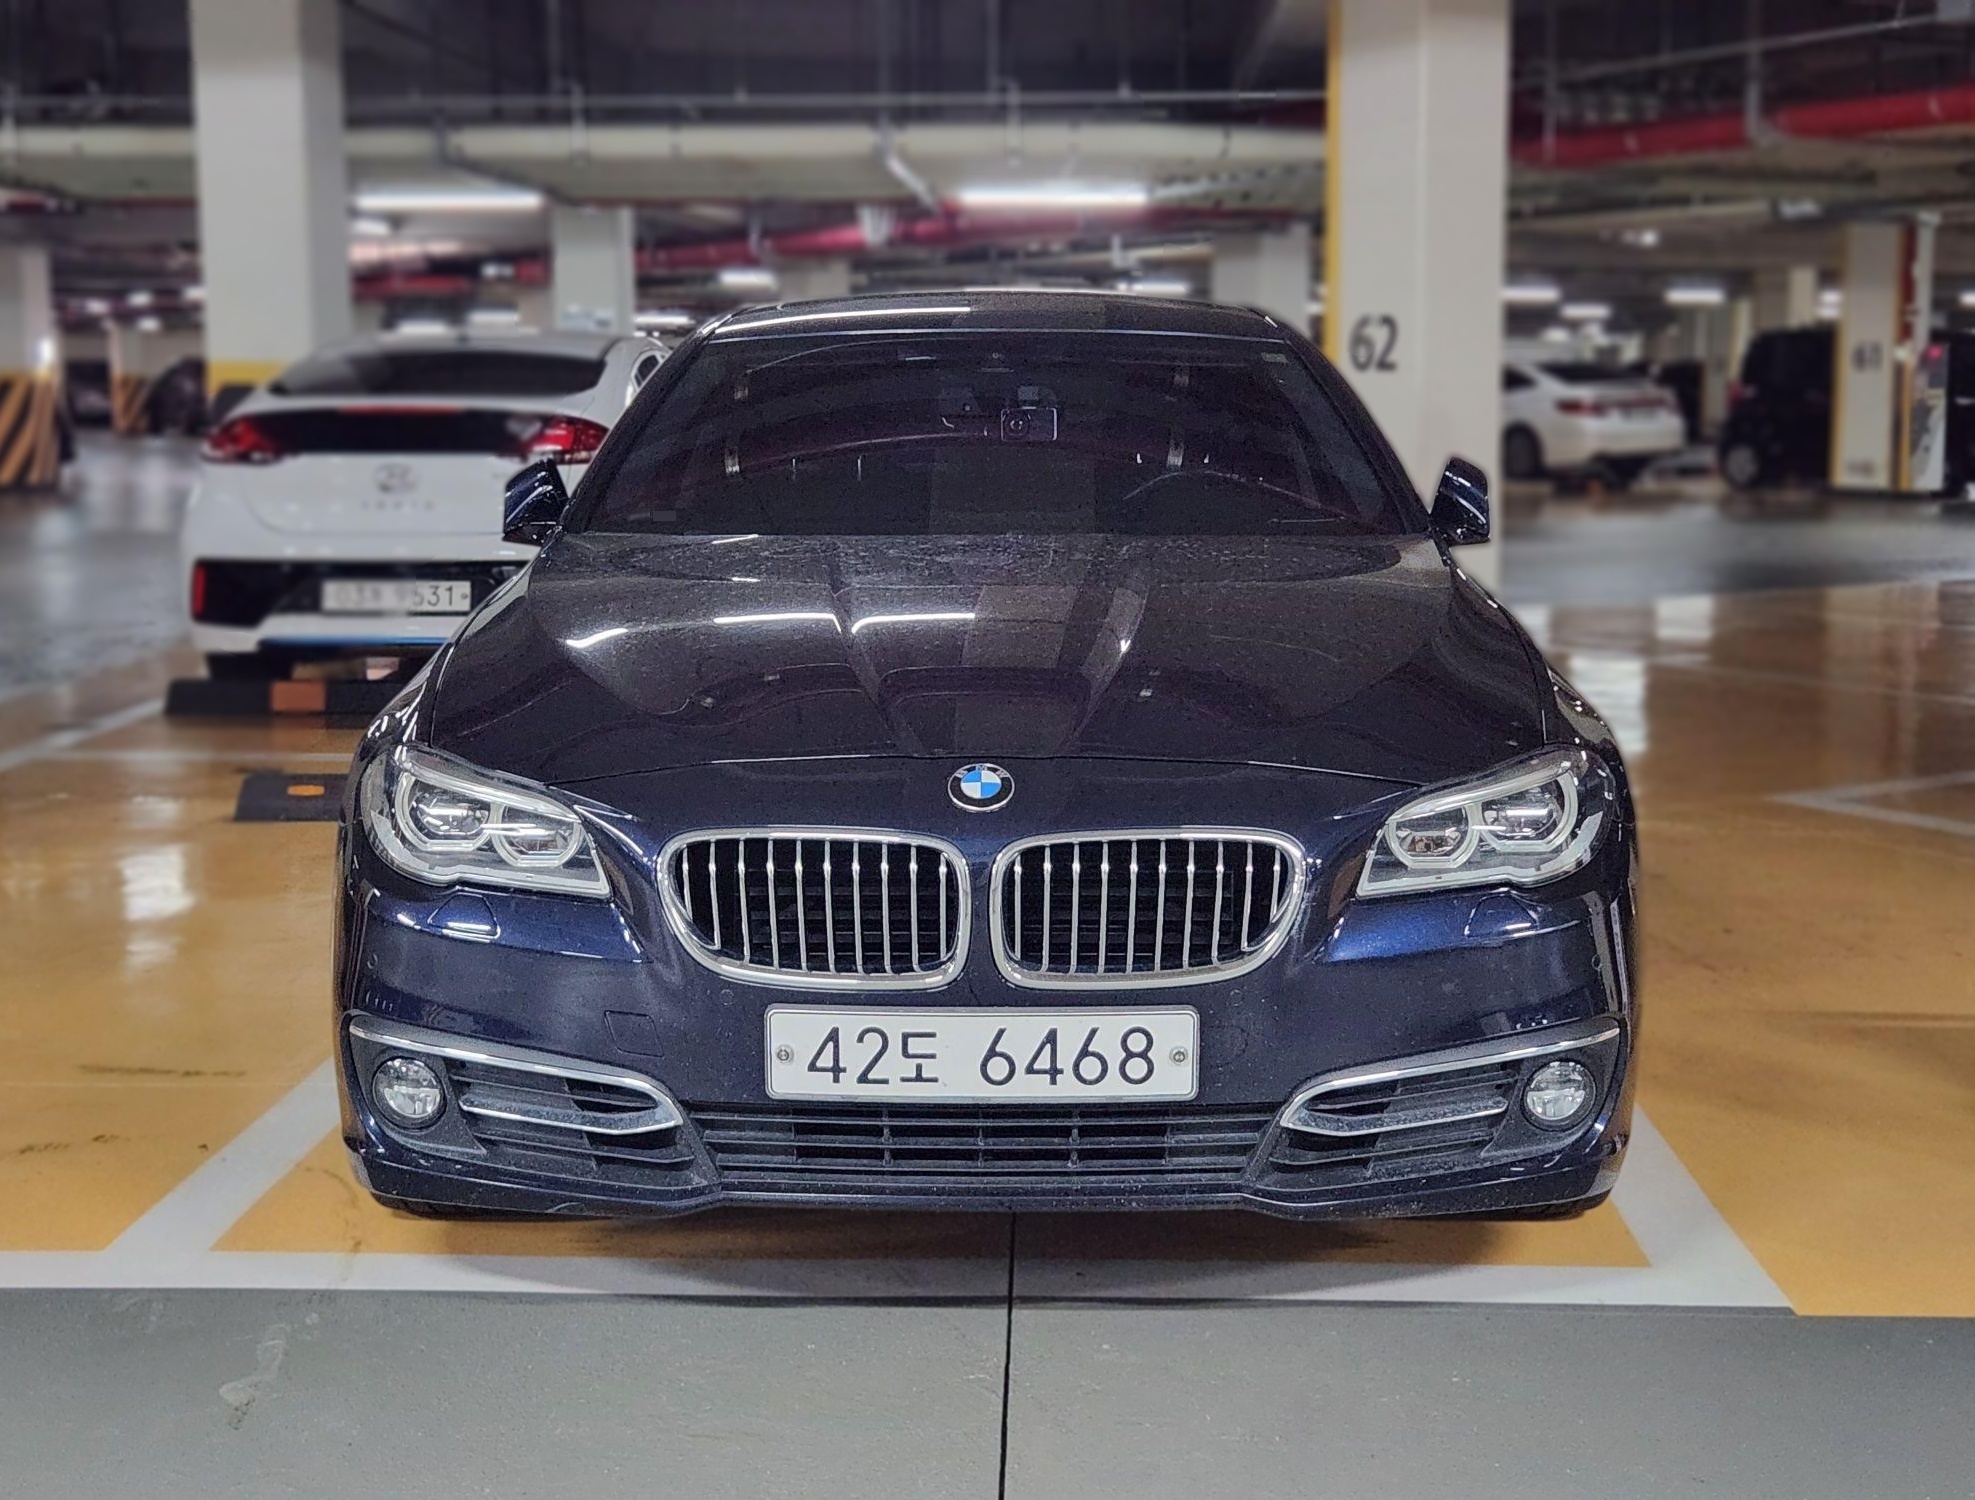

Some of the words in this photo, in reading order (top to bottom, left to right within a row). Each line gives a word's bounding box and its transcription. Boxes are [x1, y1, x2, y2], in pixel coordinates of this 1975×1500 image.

[1349, 313, 1398, 372] 62
[954, 765, 1010, 779] BMW
[807, 1026, 939, 1085] 42도
[979, 1026, 1155, 1086] 6468
